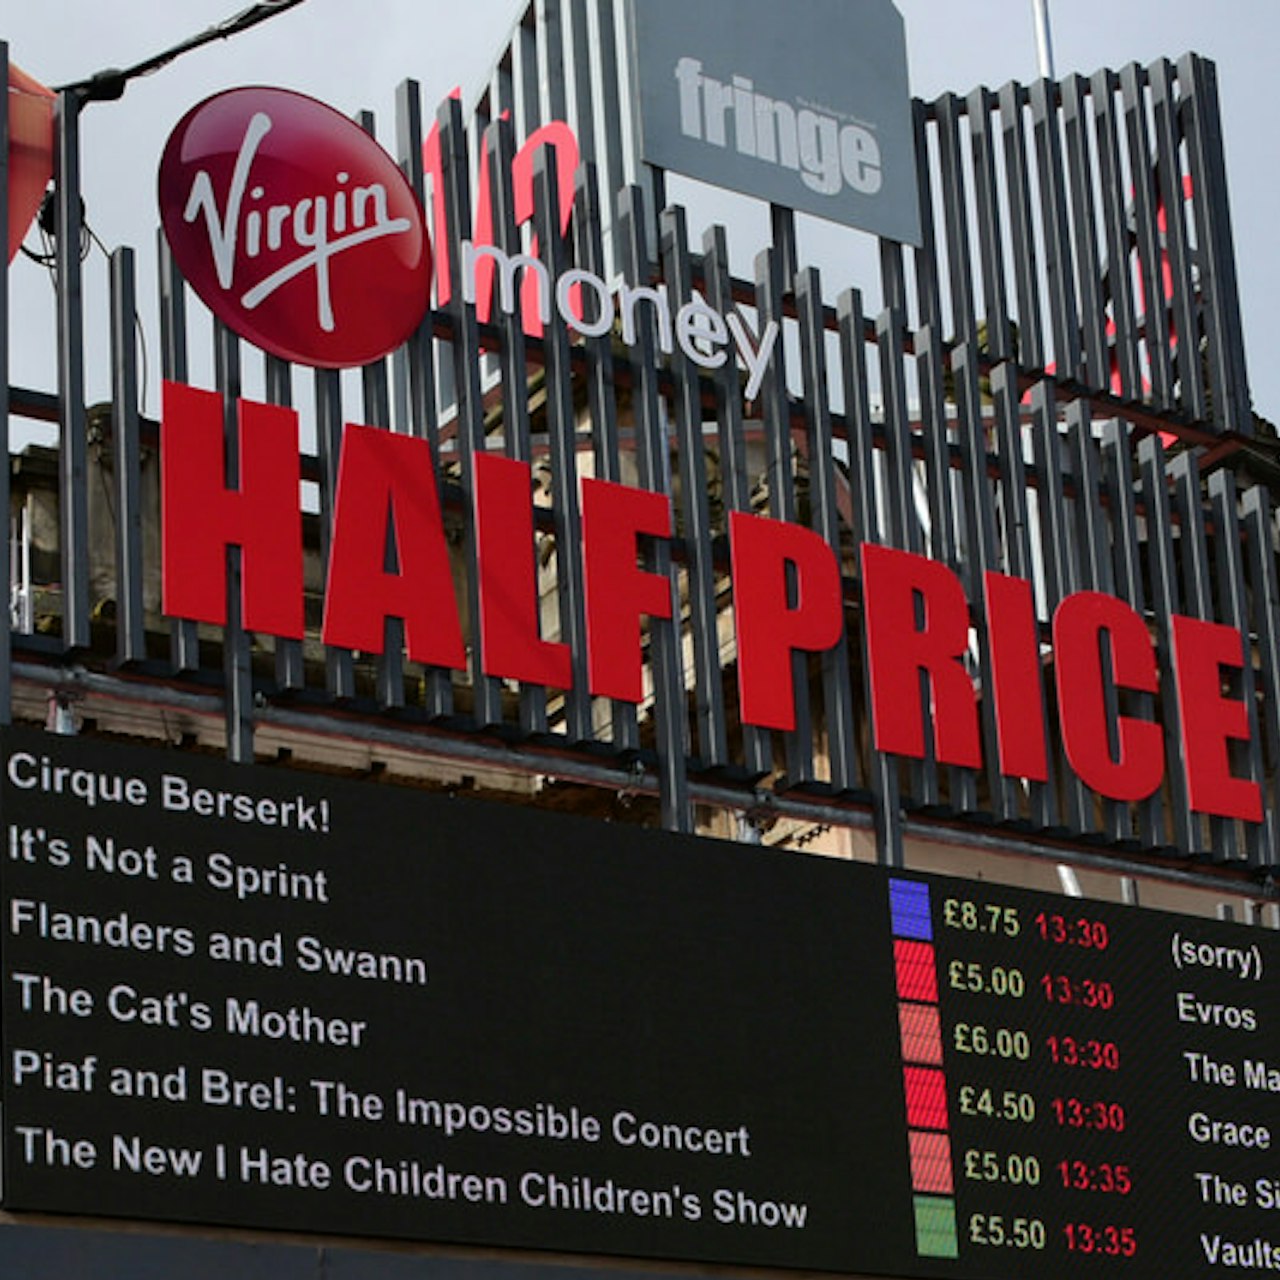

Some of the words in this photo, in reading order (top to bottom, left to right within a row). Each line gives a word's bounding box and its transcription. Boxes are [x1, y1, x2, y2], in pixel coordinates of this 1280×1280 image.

[675, 57, 882, 196] fringe
[184, 112, 411, 332] Virgin
[461, 240, 778, 403] money
[161, 380, 673, 705] HALF
[729, 509, 1263, 823] PRICE
[8, 753, 147, 805] Cirque
[163, 775, 328, 832] Berserk!
[10, 825, 70, 865] It's
[87, 837, 158, 878] Not
[172, 857, 192, 882] a
[208, 854, 327, 902] Sprint
[12, 900, 194, 955] Flanders
[210, 933, 282, 966] and
[298, 937, 425, 983] Swann
[944, 899, 1020, 936] £8.75
[1036, 913, 1108, 949] 13:30
[1172, 933, 1262, 980] (sorry)
[949, 961, 1023, 997] £5.00
[1041, 975, 1113, 1009] 13:30
[13, 974, 92, 1016] The
[108, 985, 211, 1029] Cat's
[227, 998, 365, 1046] Mother
[1177, 993, 1256, 1030] Evros
[954, 1024, 1029, 1059] £6.00
[1047, 1036, 1118, 1069] 13:30
[1184, 1052, 1235, 1086] The
[14, 1050, 97, 1091] Piaf
[110, 1067, 185, 1100] and
[203, 1069, 295, 1112] Brel:
[310, 1080, 382, 1119] The
[397, 1090, 600, 1141] Impossible
[613, 1112, 750, 1156] Concert
[960, 1086, 1034, 1122] £4.50
[1052, 1098, 1124, 1131] 13:30
[1189, 1113, 1270, 1148] Grace
[16, 1127, 96, 1168] The
[113, 1136, 202, 1175] New
[217, 1145, 225, 1178] I
[241, 1147, 330, 1188] Hate
[345, 1157, 506, 1202] Children
[520, 1173, 701, 1220] Children's
[714, 1190, 807, 1227] Show
[965, 1150, 1039, 1184] £5.00
[1059, 1161, 1131, 1194] 13:35
[1195, 1173, 1247, 1206] The
[970, 1214, 1045, 1249] £5.50
[1064, 1224, 1136, 1256] 13:35
